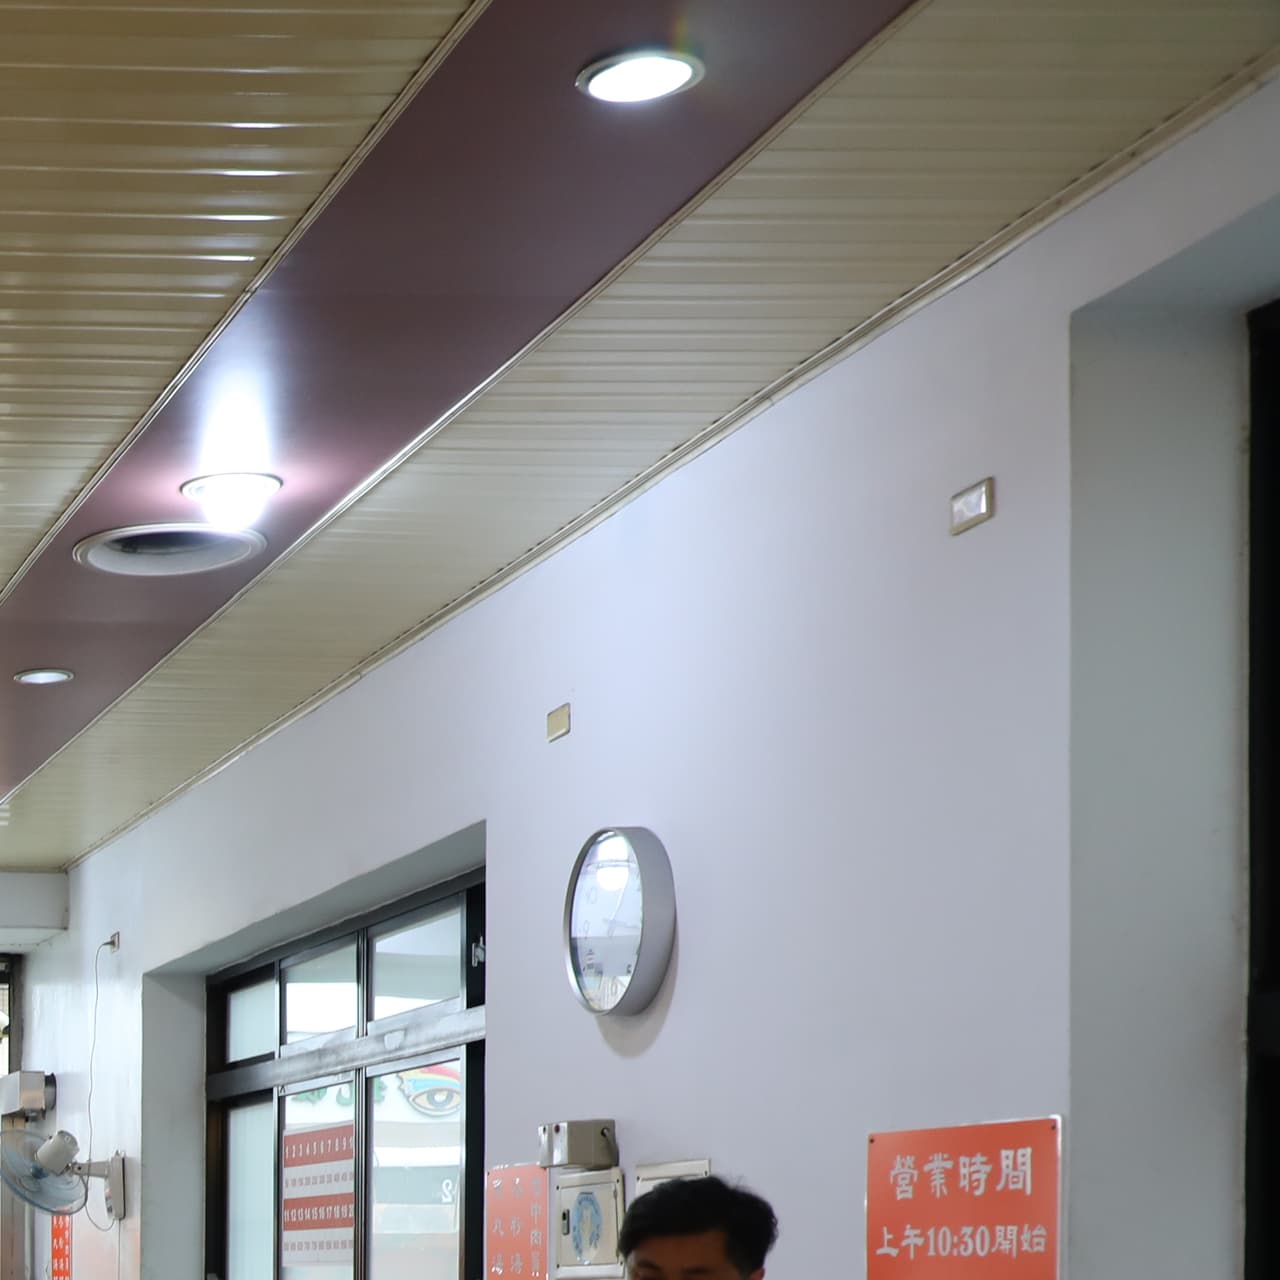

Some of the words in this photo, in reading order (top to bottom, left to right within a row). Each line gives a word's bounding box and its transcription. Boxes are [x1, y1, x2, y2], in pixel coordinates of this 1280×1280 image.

[890, 1147, 1032, 1200] 營業時間
[876, 1223, 1047, 1260] 上午10:30開始
